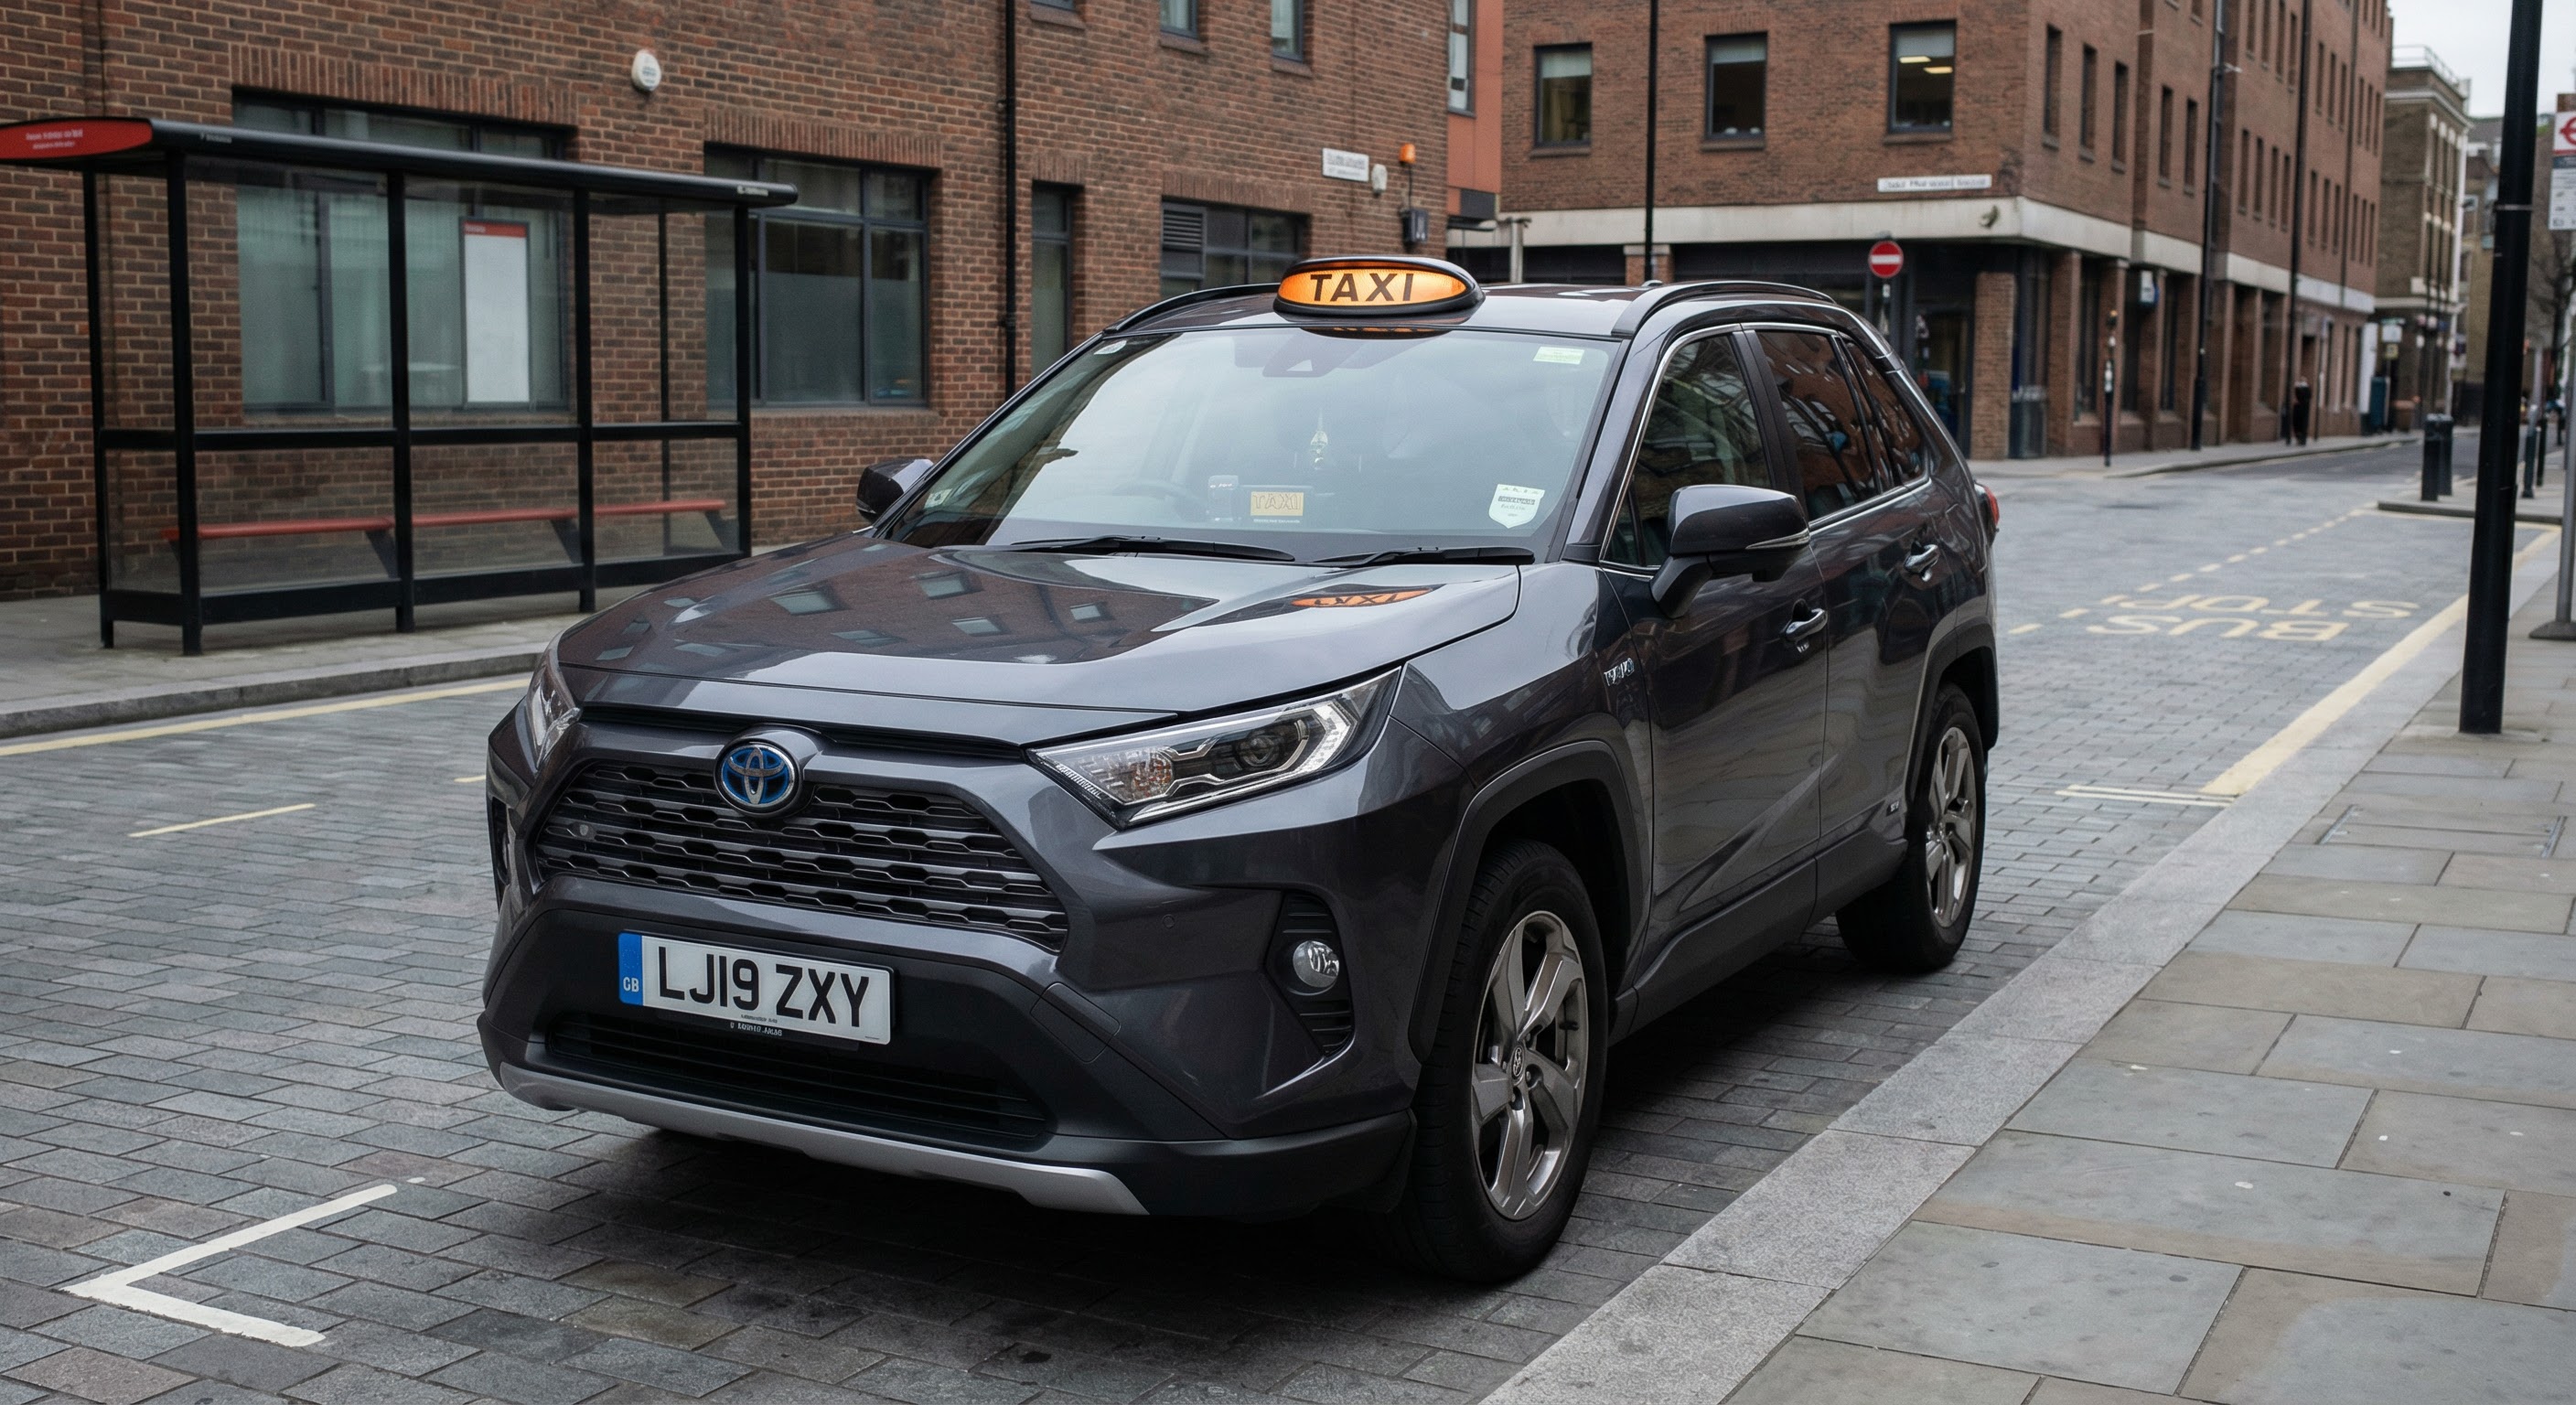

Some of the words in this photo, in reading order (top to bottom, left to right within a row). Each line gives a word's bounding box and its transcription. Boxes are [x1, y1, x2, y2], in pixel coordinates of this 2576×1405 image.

[1310, 273, 1414, 302] TAXI
[2117, 595, 2421, 619] STOP
[2086, 615, 2350, 641] BUS
[658, 945, 759, 1012] LJ19
[775, 963, 870, 1028] ZXY
